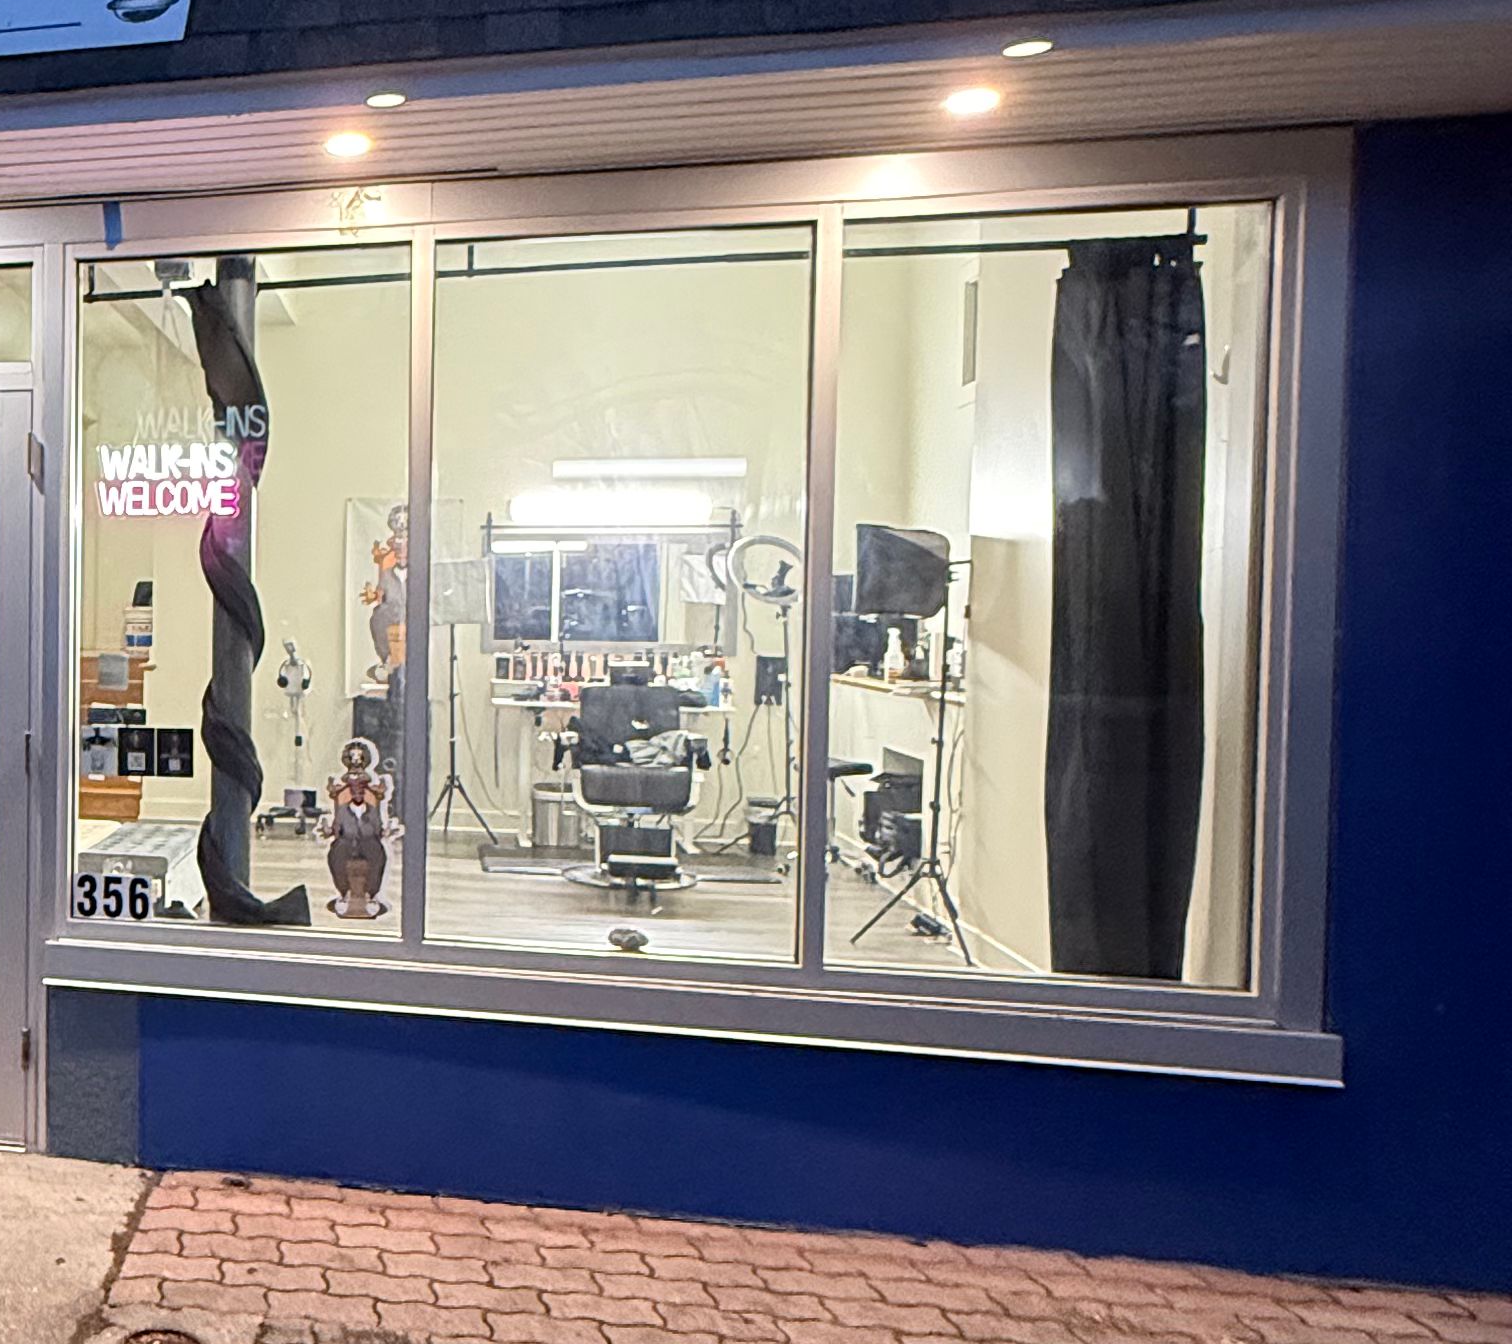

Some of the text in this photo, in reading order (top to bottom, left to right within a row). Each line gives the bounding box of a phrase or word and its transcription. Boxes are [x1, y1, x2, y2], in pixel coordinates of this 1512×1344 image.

[98, 442, 238, 481] WALK-INS
[97, 479, 239, 517] WELCOME
[77, 874, 149, 920] 356
